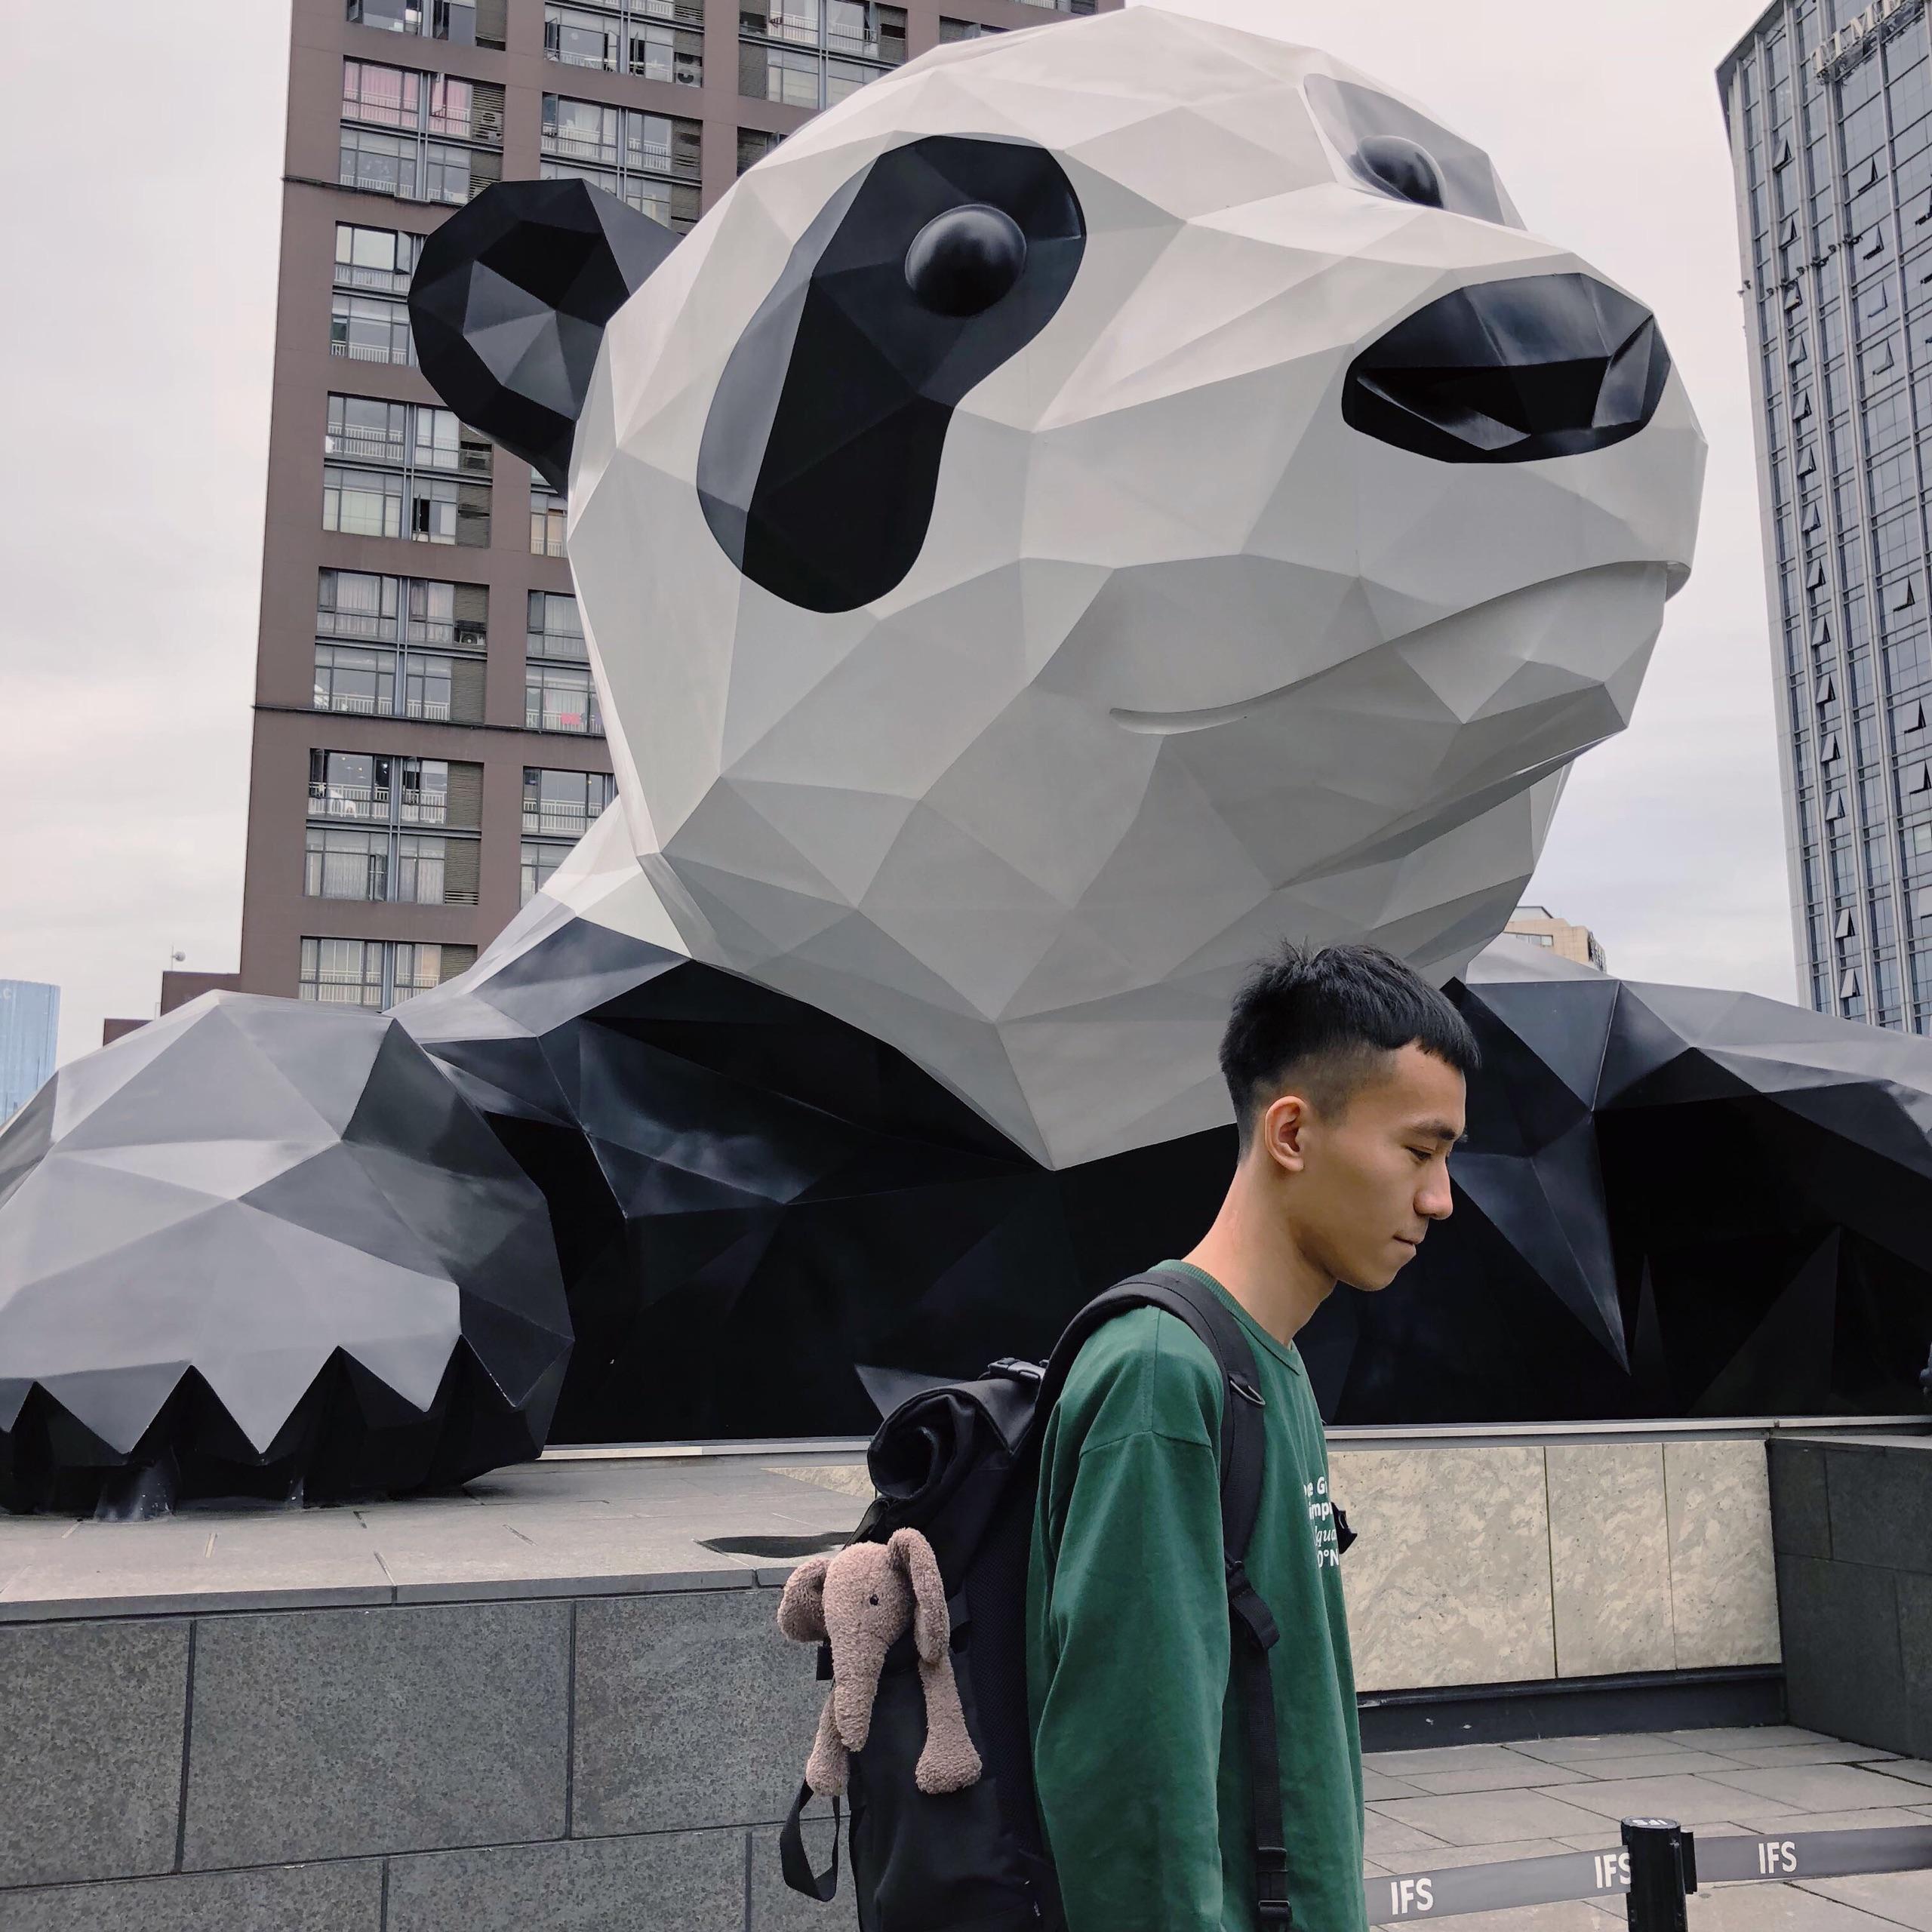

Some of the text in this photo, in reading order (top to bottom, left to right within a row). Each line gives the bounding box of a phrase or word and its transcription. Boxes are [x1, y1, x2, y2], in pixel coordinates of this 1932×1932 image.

[1317, 1476, 1328, 1495] G
[1594, 1852, 1632, 1888] IFS
[1758, 1841, 1797, 1874] IFS
[1390, 1878, 1434, 1915] IFS
